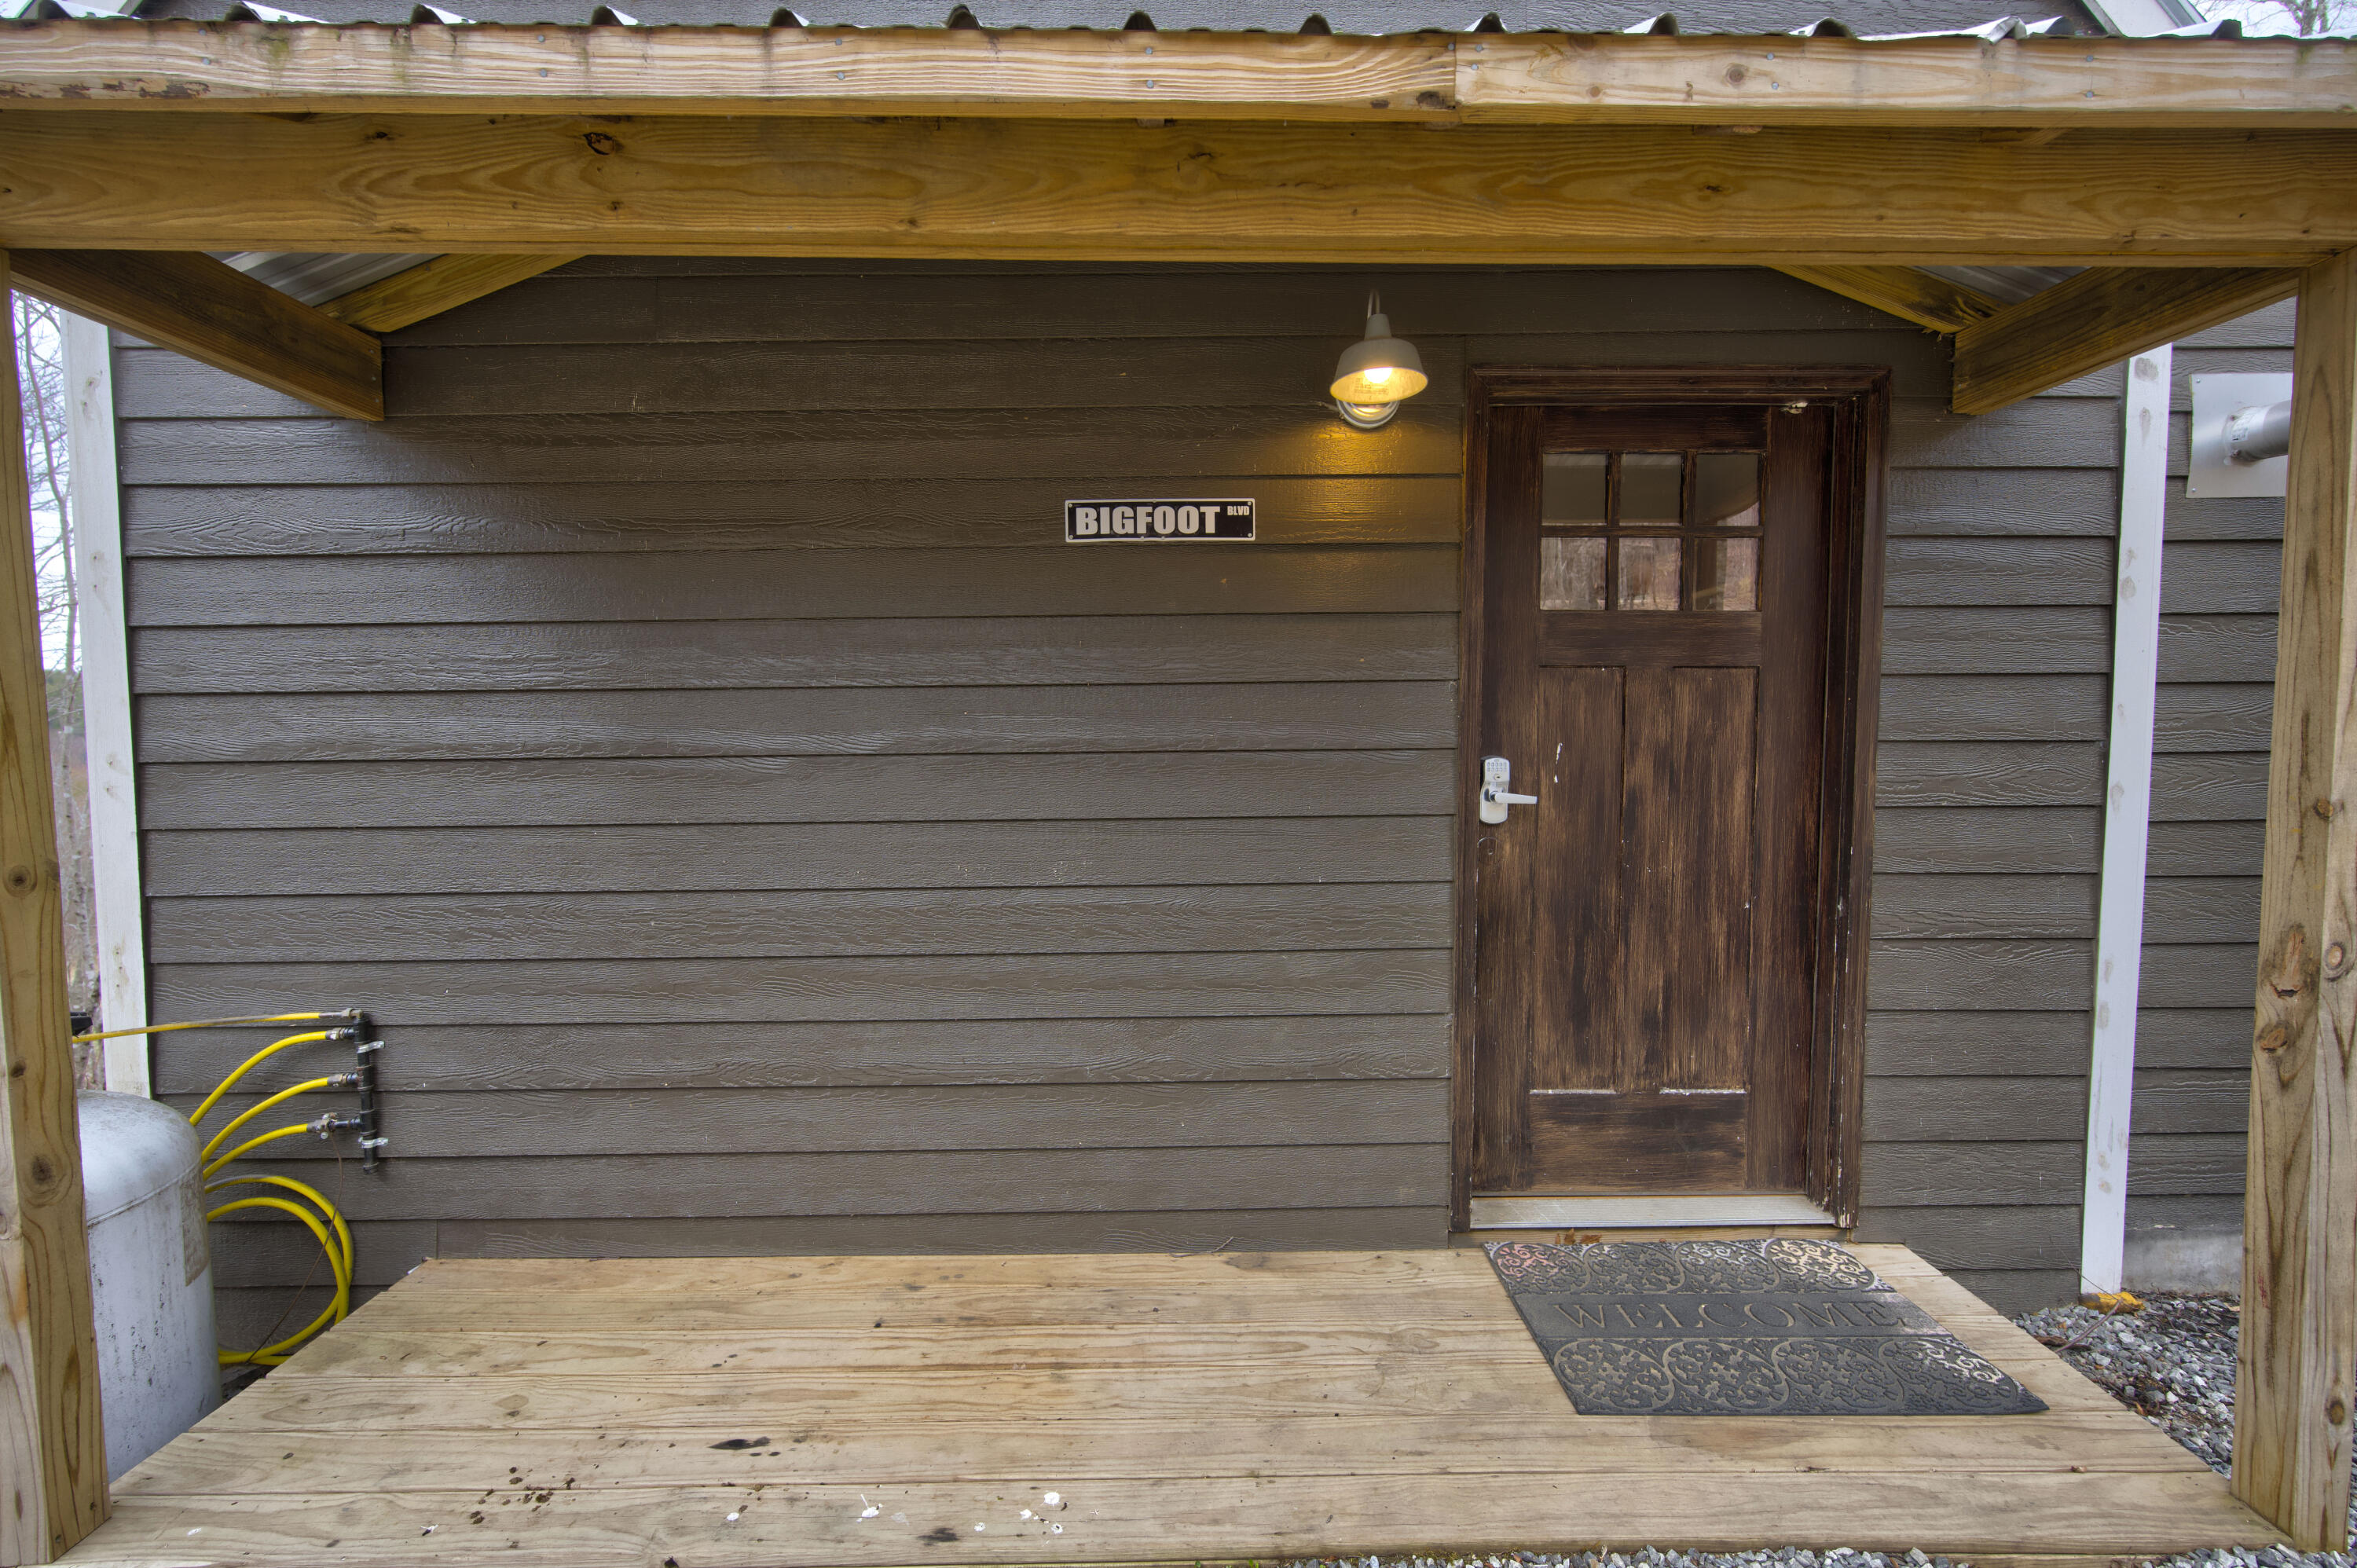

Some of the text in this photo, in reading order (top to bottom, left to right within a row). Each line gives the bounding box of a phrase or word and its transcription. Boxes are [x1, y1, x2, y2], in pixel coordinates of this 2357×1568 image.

[1076, 505, 1250, 535] BIGFOOT BLVD
[1552, 1302, 1907, 1329] WELCOME
